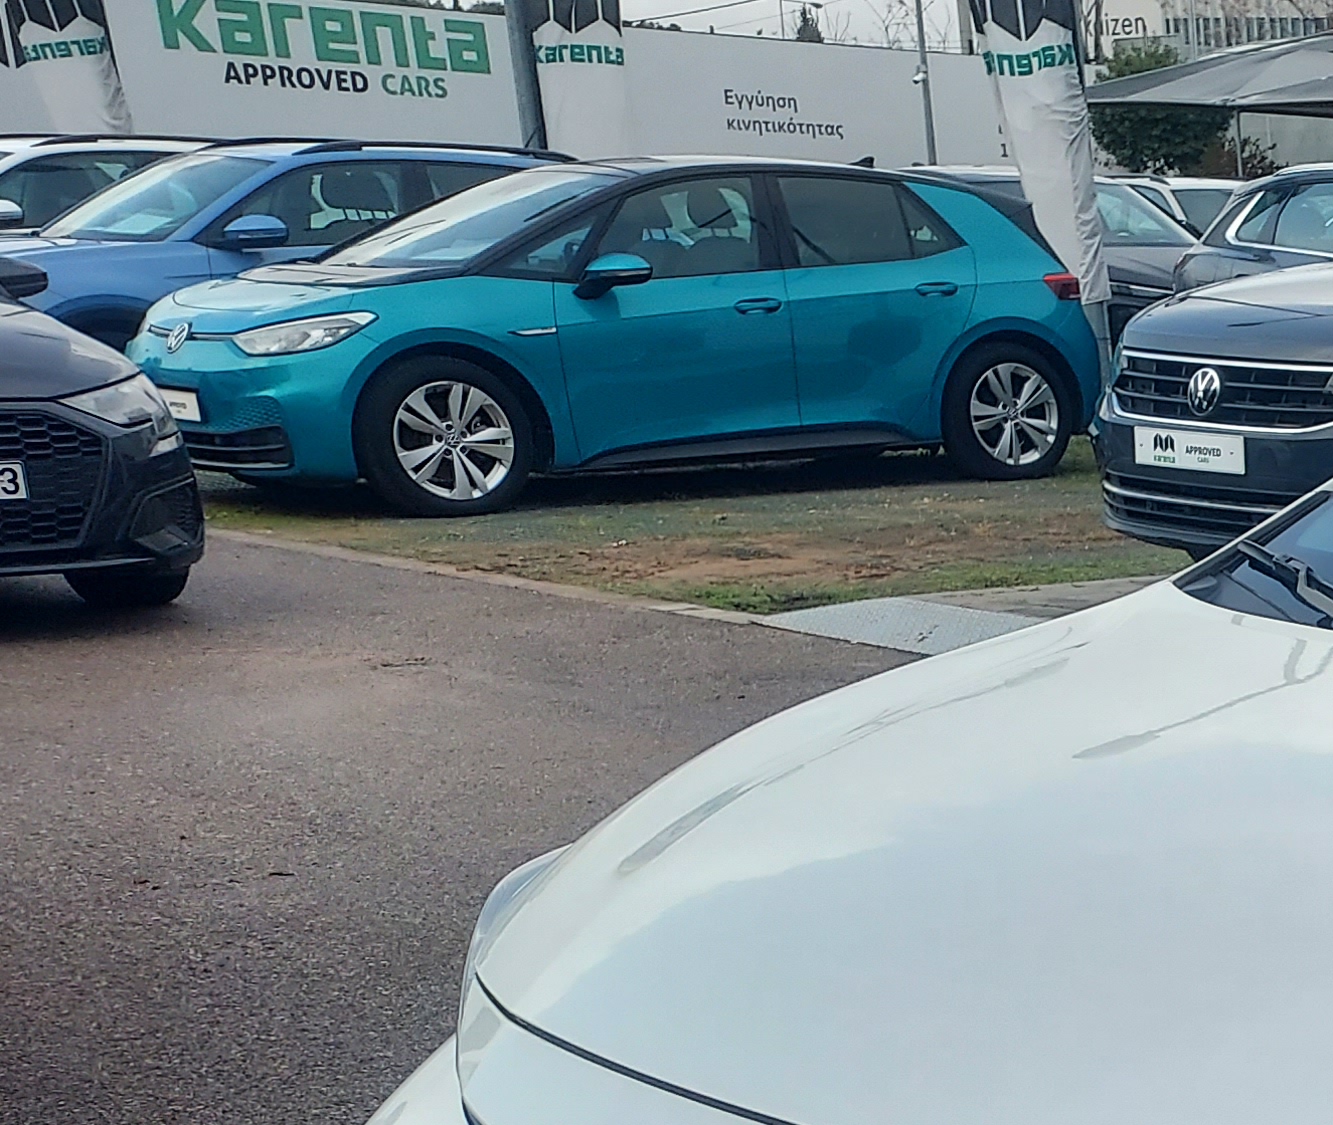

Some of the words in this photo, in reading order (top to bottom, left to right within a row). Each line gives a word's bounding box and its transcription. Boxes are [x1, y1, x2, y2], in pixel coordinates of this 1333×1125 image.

[1084, 12, 1148, 37] kizen
[224, 61, 369, 93] APPROVED
[381, 73, 448, 98] CARS
[724, 88, 798, 113] Εγγύηση
[726, 117, 844, 140] κινητικότητας
